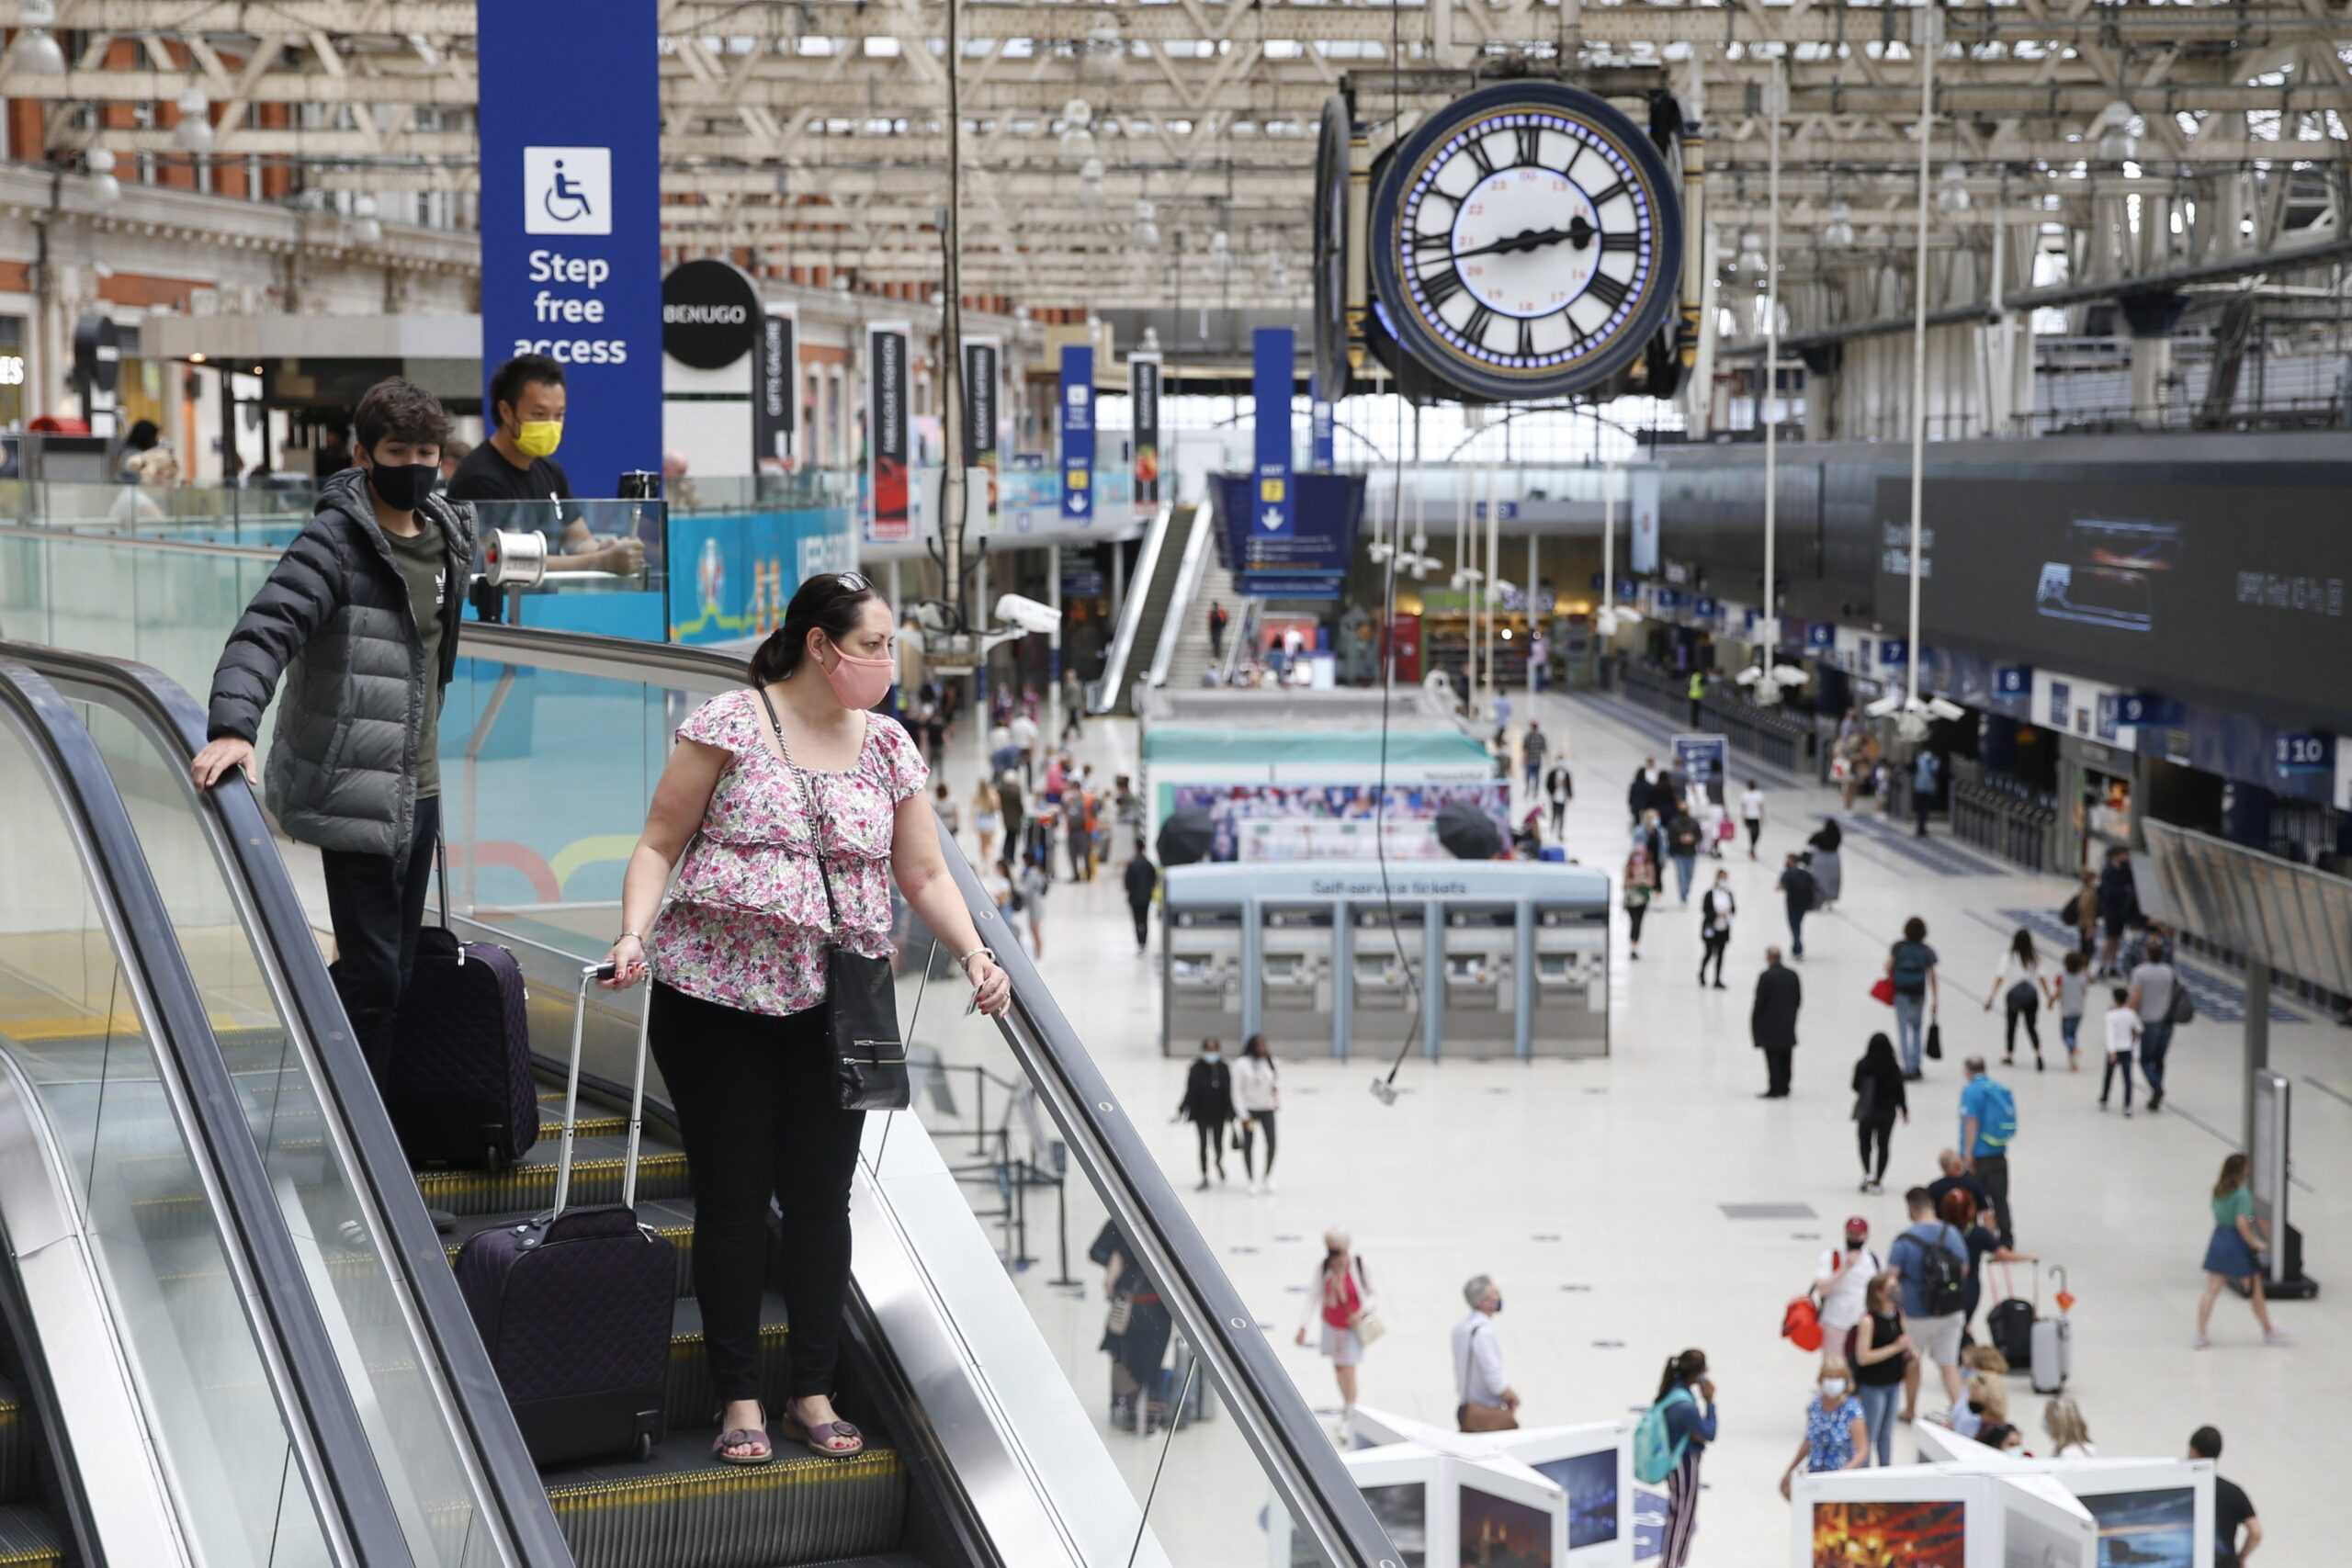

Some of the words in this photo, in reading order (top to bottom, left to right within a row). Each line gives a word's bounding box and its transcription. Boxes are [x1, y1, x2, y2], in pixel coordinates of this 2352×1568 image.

[528, 250, 610, 289] Step
[534, 290, 605, 322] free
[662, 304, 746, 324] BENUGO
[513, 339, 628, 364] access
[765, 321, 782, 377] GALORE
[882, 335, 898, 390] FASHION
[766, 378, 784, 416] GIFTS
[882, 392, 898, 453] FABULOUS
[1889, 643, 1901, 660] 7
[2007, 670, 2020, 691] 8
[2128, 698, 2143, 720] 9
[2292, 738, 2323, 762] 10
[1312, 879, 1408, 895] Self-servce
